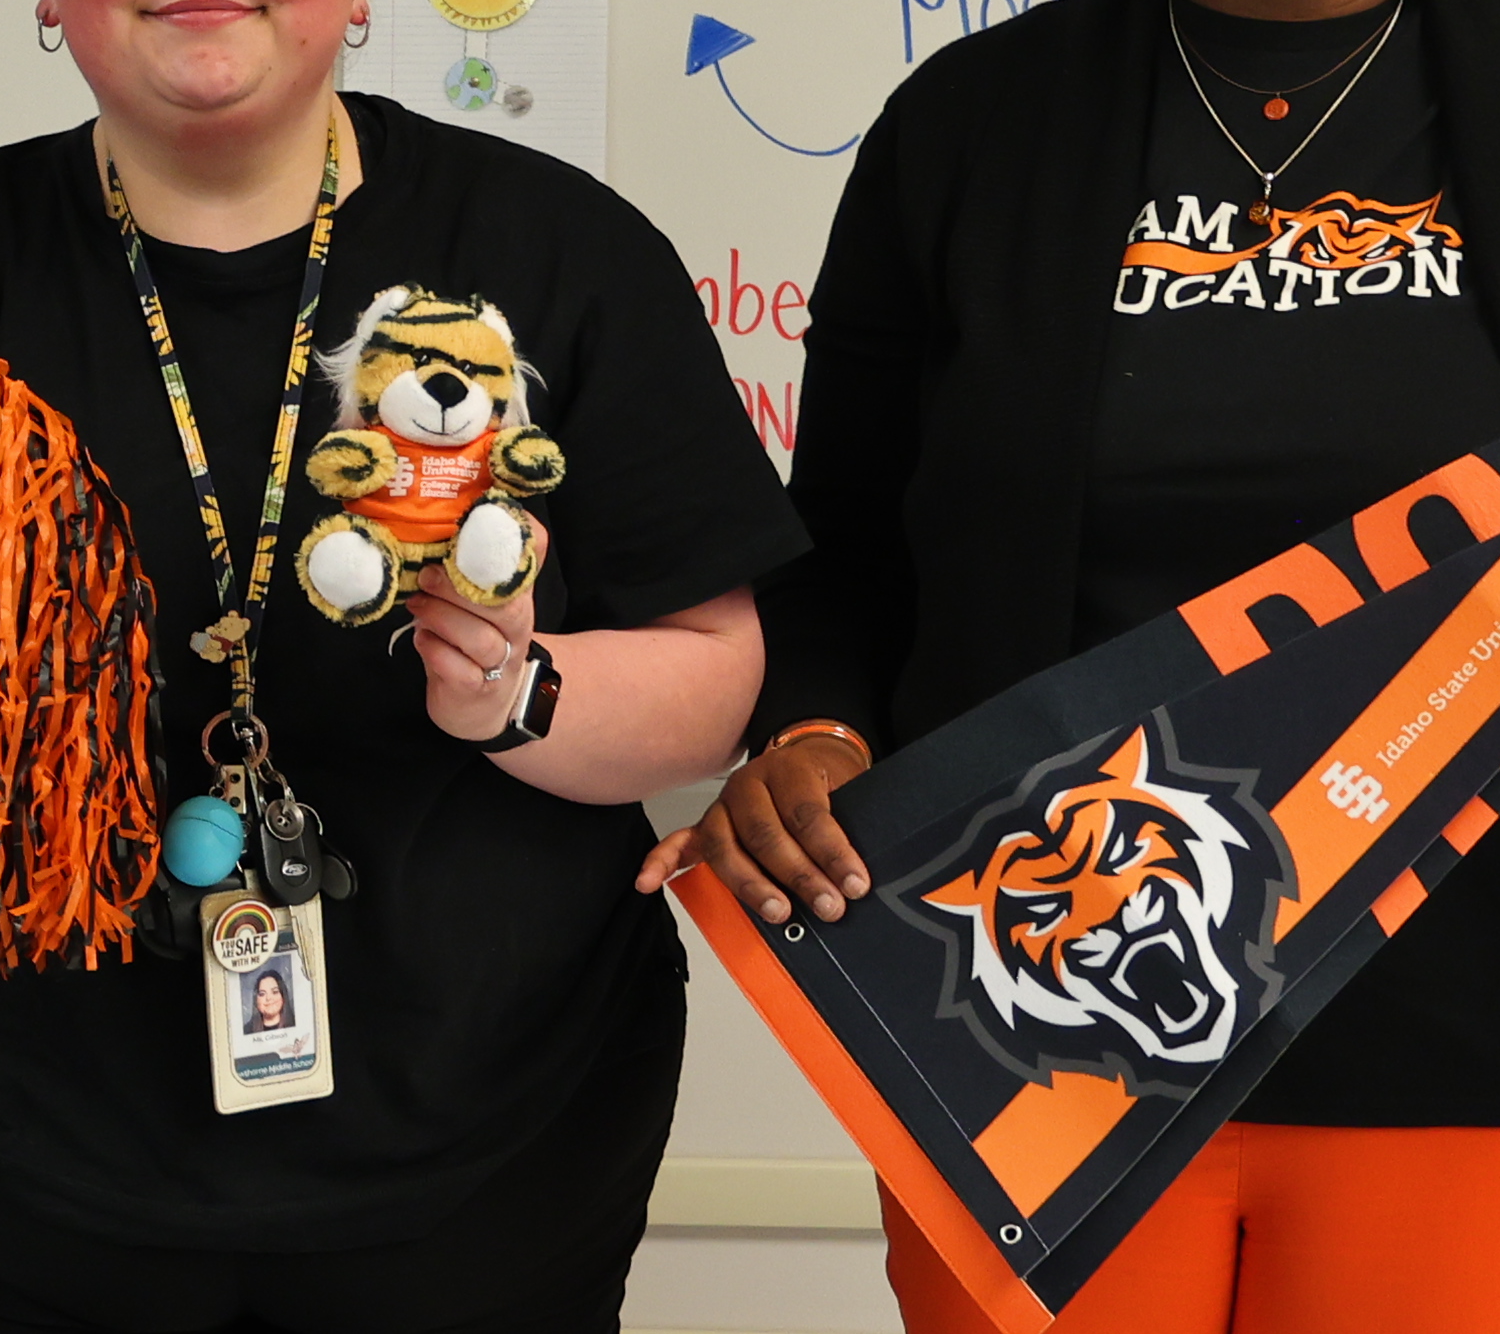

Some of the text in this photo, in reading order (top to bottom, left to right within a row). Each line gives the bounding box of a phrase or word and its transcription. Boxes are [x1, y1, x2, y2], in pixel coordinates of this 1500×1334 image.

[1112, 248, 1464, 316] UCATION
[421, 455, 457, 467] Idaho
[421, 466, 480, 481] University
[1375, 710, 1434, 769] Idaho
[1427, 660, 1479, 713] State
[221, 939, 236, 951] YOU
[236, 934, 270, 957] SAFE
[231, 955, 261, 967] WITH ME
